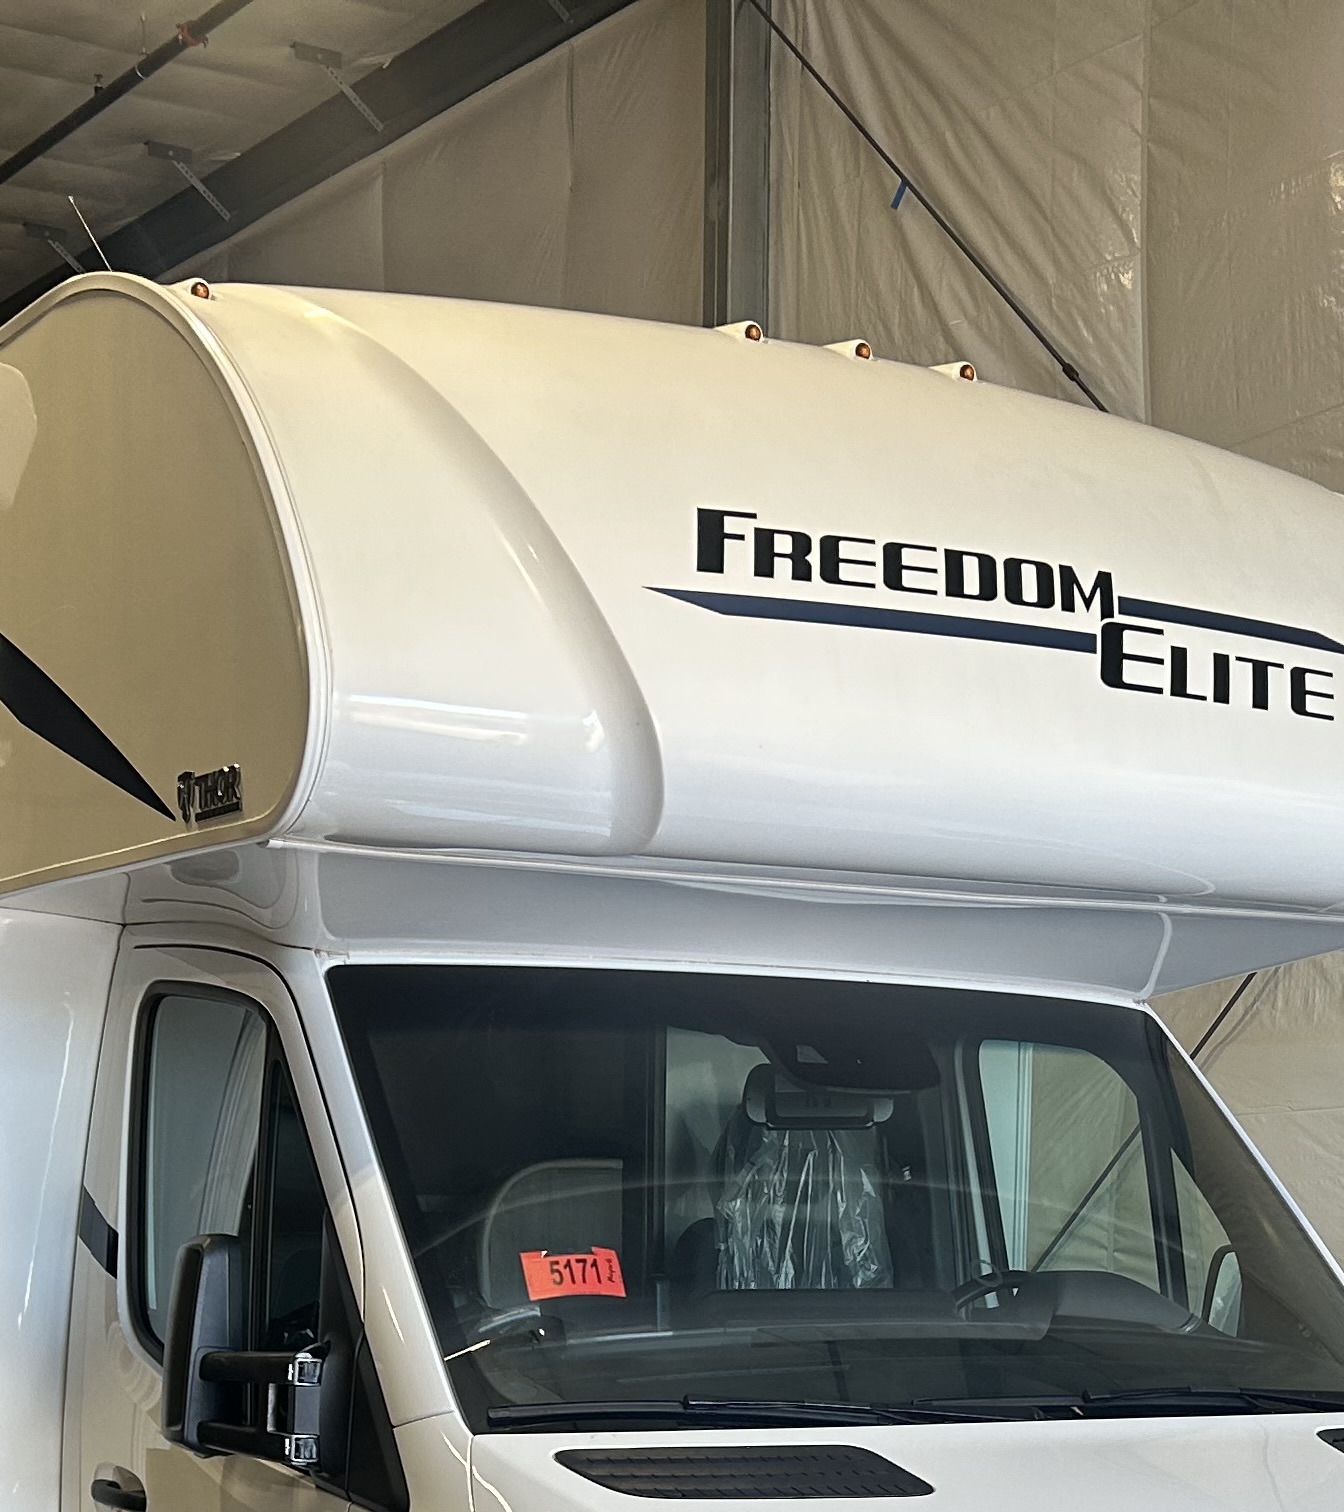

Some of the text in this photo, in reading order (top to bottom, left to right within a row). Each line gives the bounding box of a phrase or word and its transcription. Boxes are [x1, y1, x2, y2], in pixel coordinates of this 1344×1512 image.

[696, 507, 1115, 622] FREEDOM
[1100, 620, 1335, 721] ELITE
[194, 764, 242, 811] THOR
[549, 1257, 602, 1286] 5171
